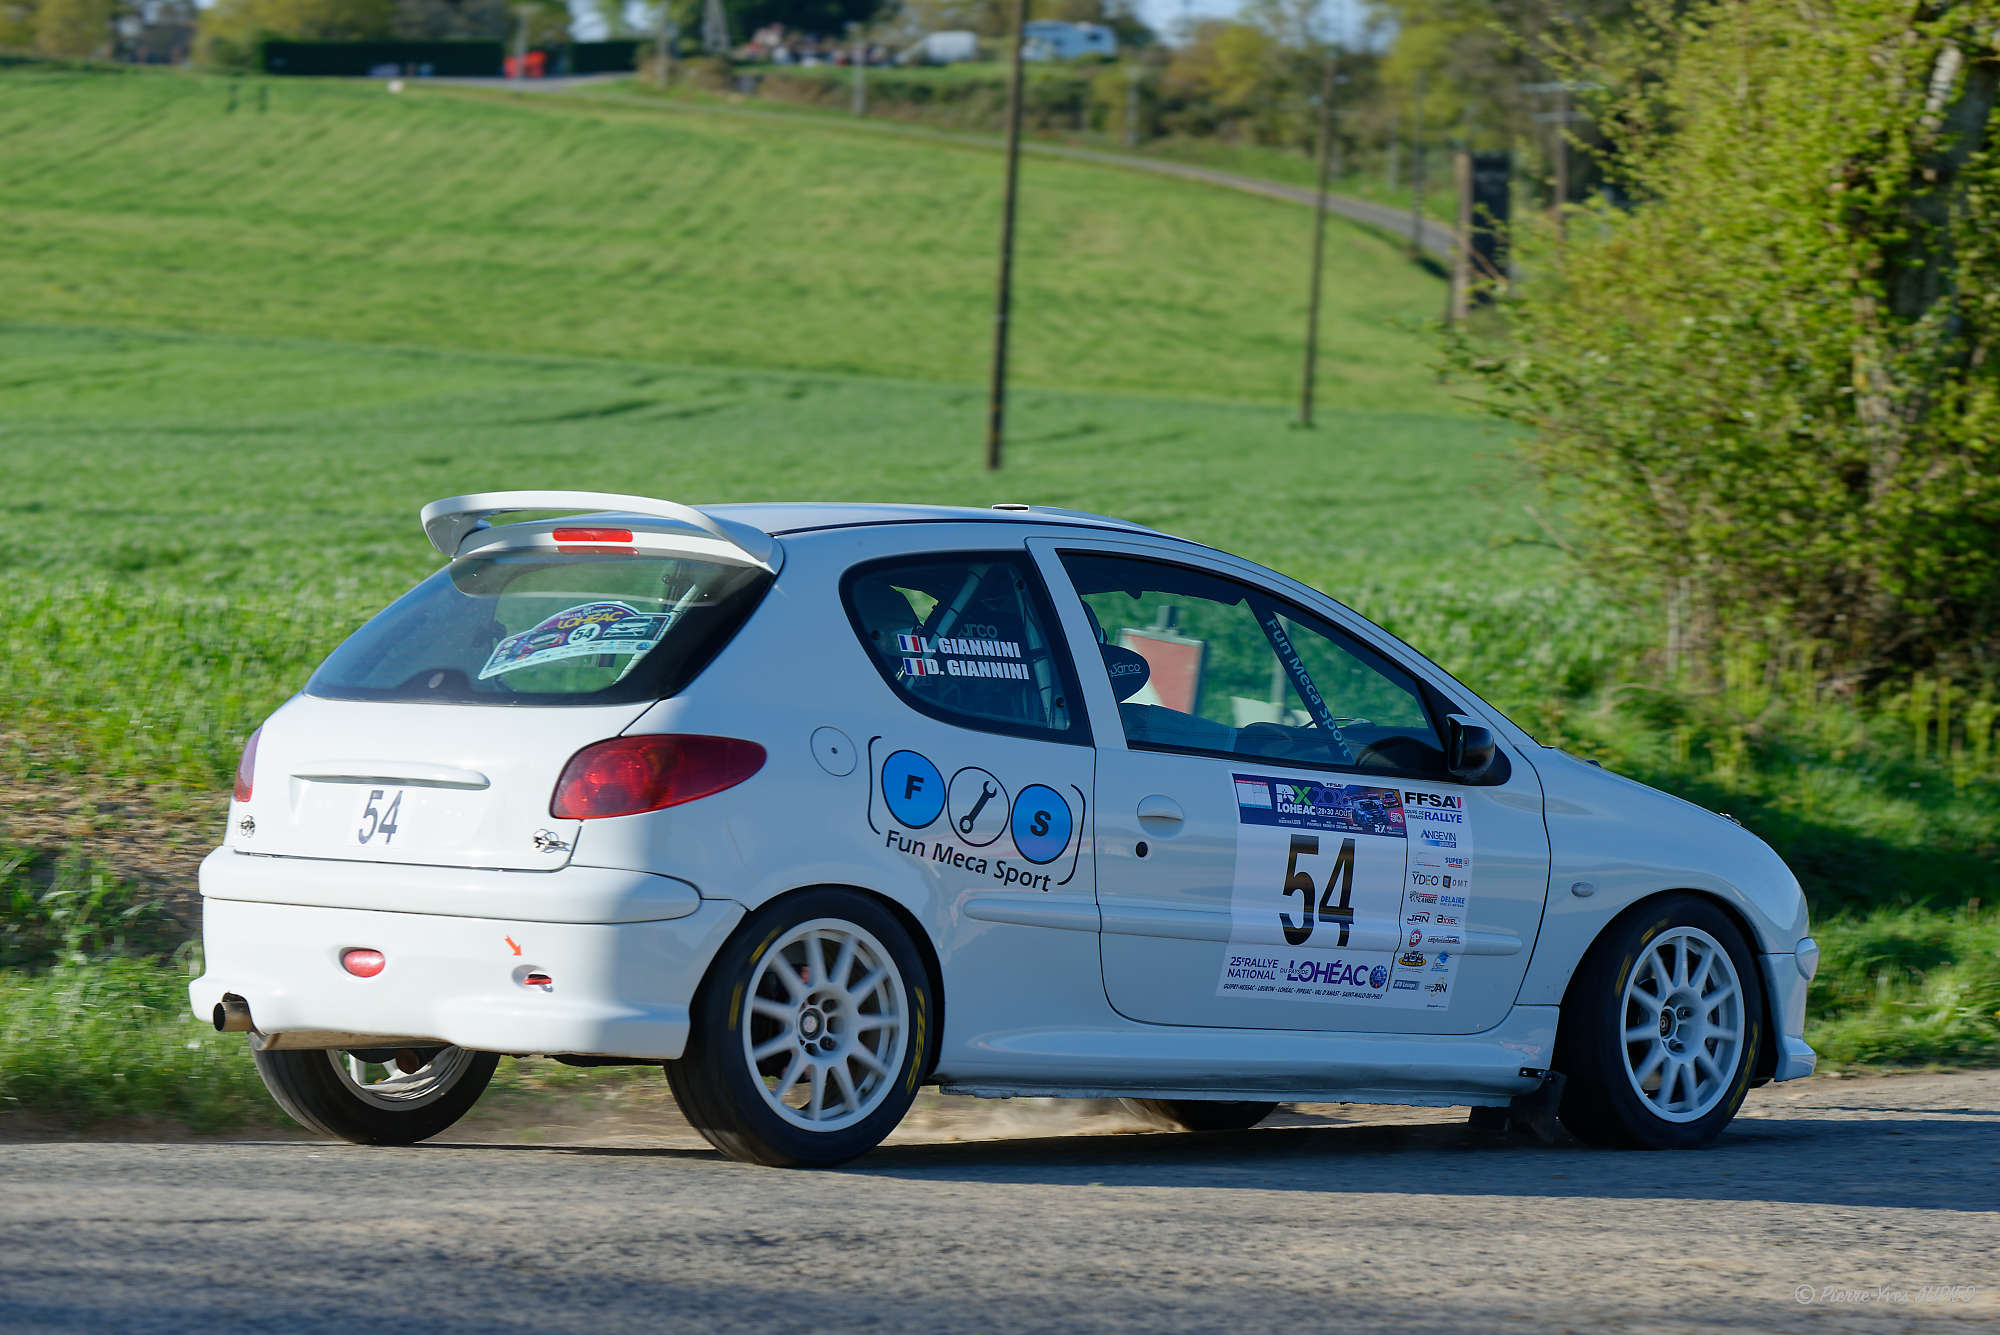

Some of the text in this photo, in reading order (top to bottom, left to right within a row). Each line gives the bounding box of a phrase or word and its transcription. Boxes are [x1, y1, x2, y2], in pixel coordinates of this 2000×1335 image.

[572, 626, 595, 641] 54
[938, 637, 1021, 658] GIANNINI
[925, 658, 1029, 680] D. GIANNINI
[1265, 618, 1353, 757] Fun Meca Sport
[1275, 783, 1313, 805] RX
[1404, 791, 1457, 809] FFSA
[904, 774, 1051, 837] F S
[1277, 802, 1316, 816] LOHEAC
[357, 789, 404, 846] 54
[1424, 811, 1463, 824] RALLYE
[1421, 829, 1456, 841] ANGEVIN
[885, 829, 1051, 892] Fun Meca Sport
[1445, 857, 1463, 865] SUPER
[1279, 834, 1355, 947] 54
[1244, 958, 1279, 969] RALLYE
[1287, 959, 1369, 986] LOHÉAC
[1227, 968, 1276, 981] NATIONAL
